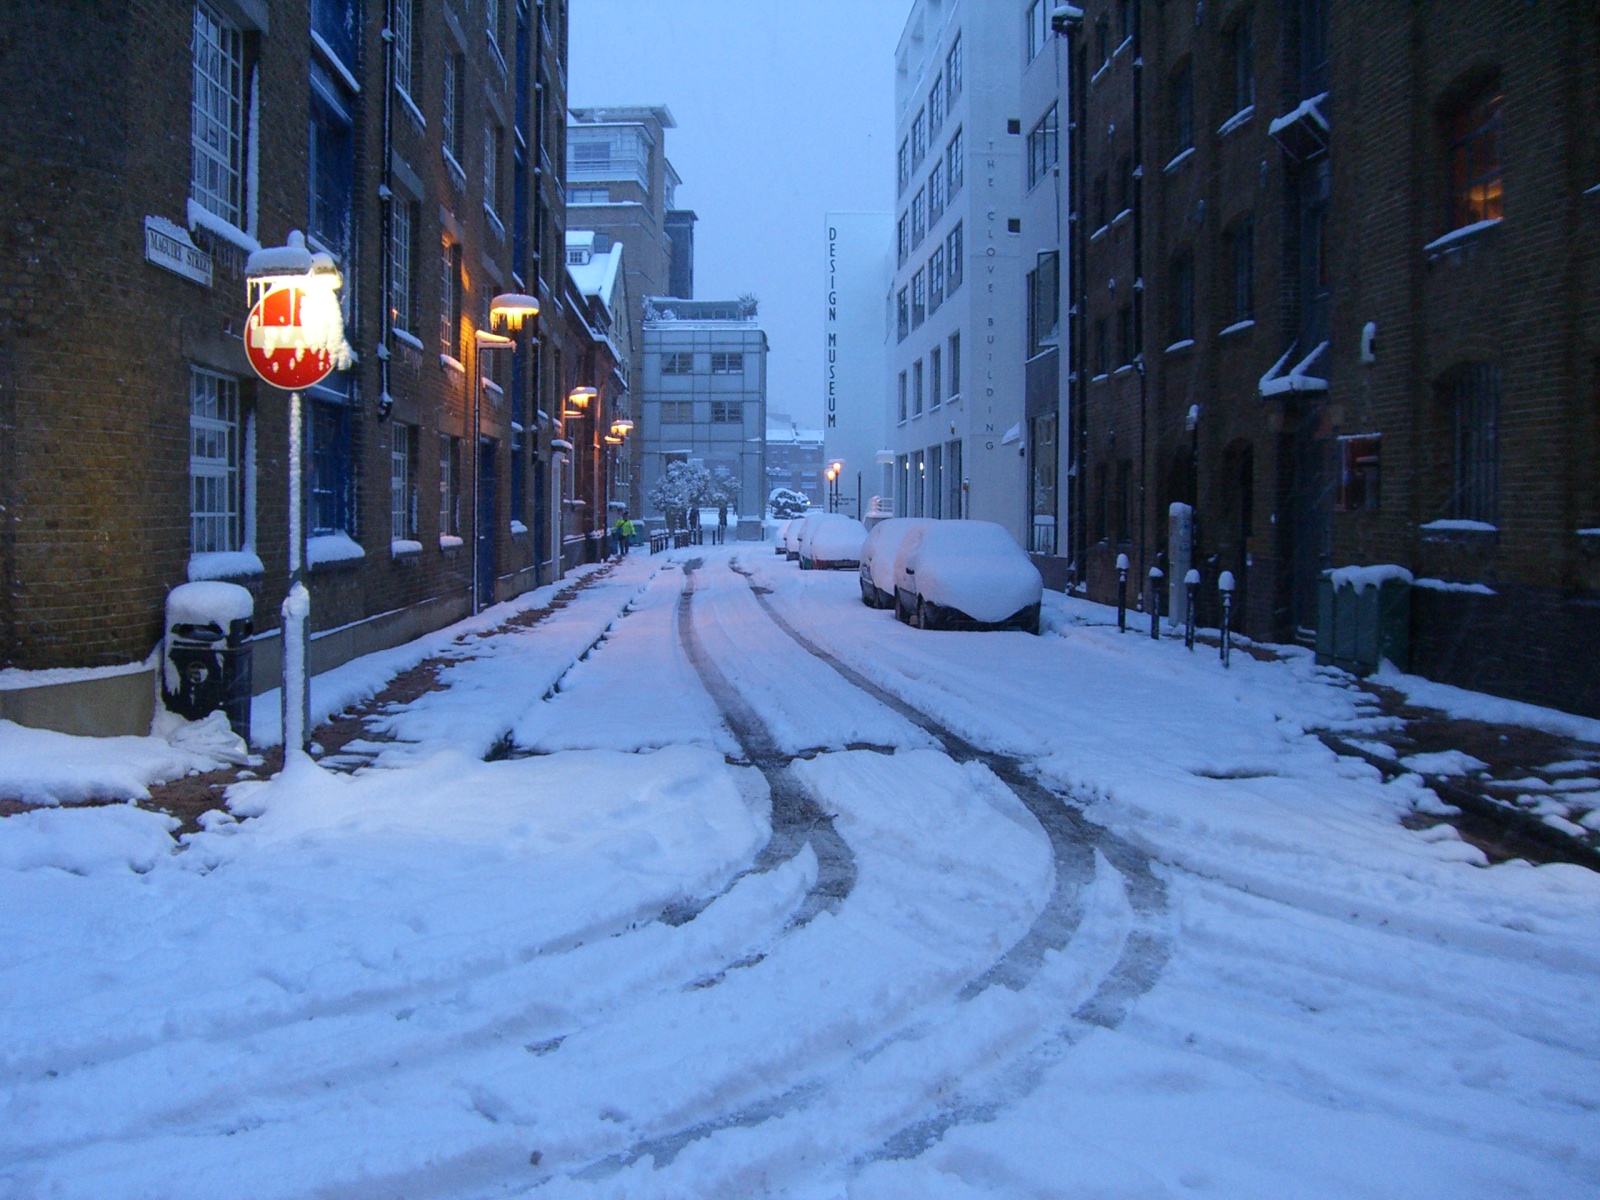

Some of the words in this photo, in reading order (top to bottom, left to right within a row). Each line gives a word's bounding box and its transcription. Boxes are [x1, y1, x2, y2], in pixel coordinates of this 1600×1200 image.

[987, 141, 995, 187] THE
[149, 229, 182, 262] MAGUIRE
[186, 249, 211, 274] STREET
[828, 226, 837, 321] DESIGN
[986, 211, 996, 293] CLOVE
[828, 333, 837, 428] MUSEUM
[985, 317, 995, 450] BUILDING
